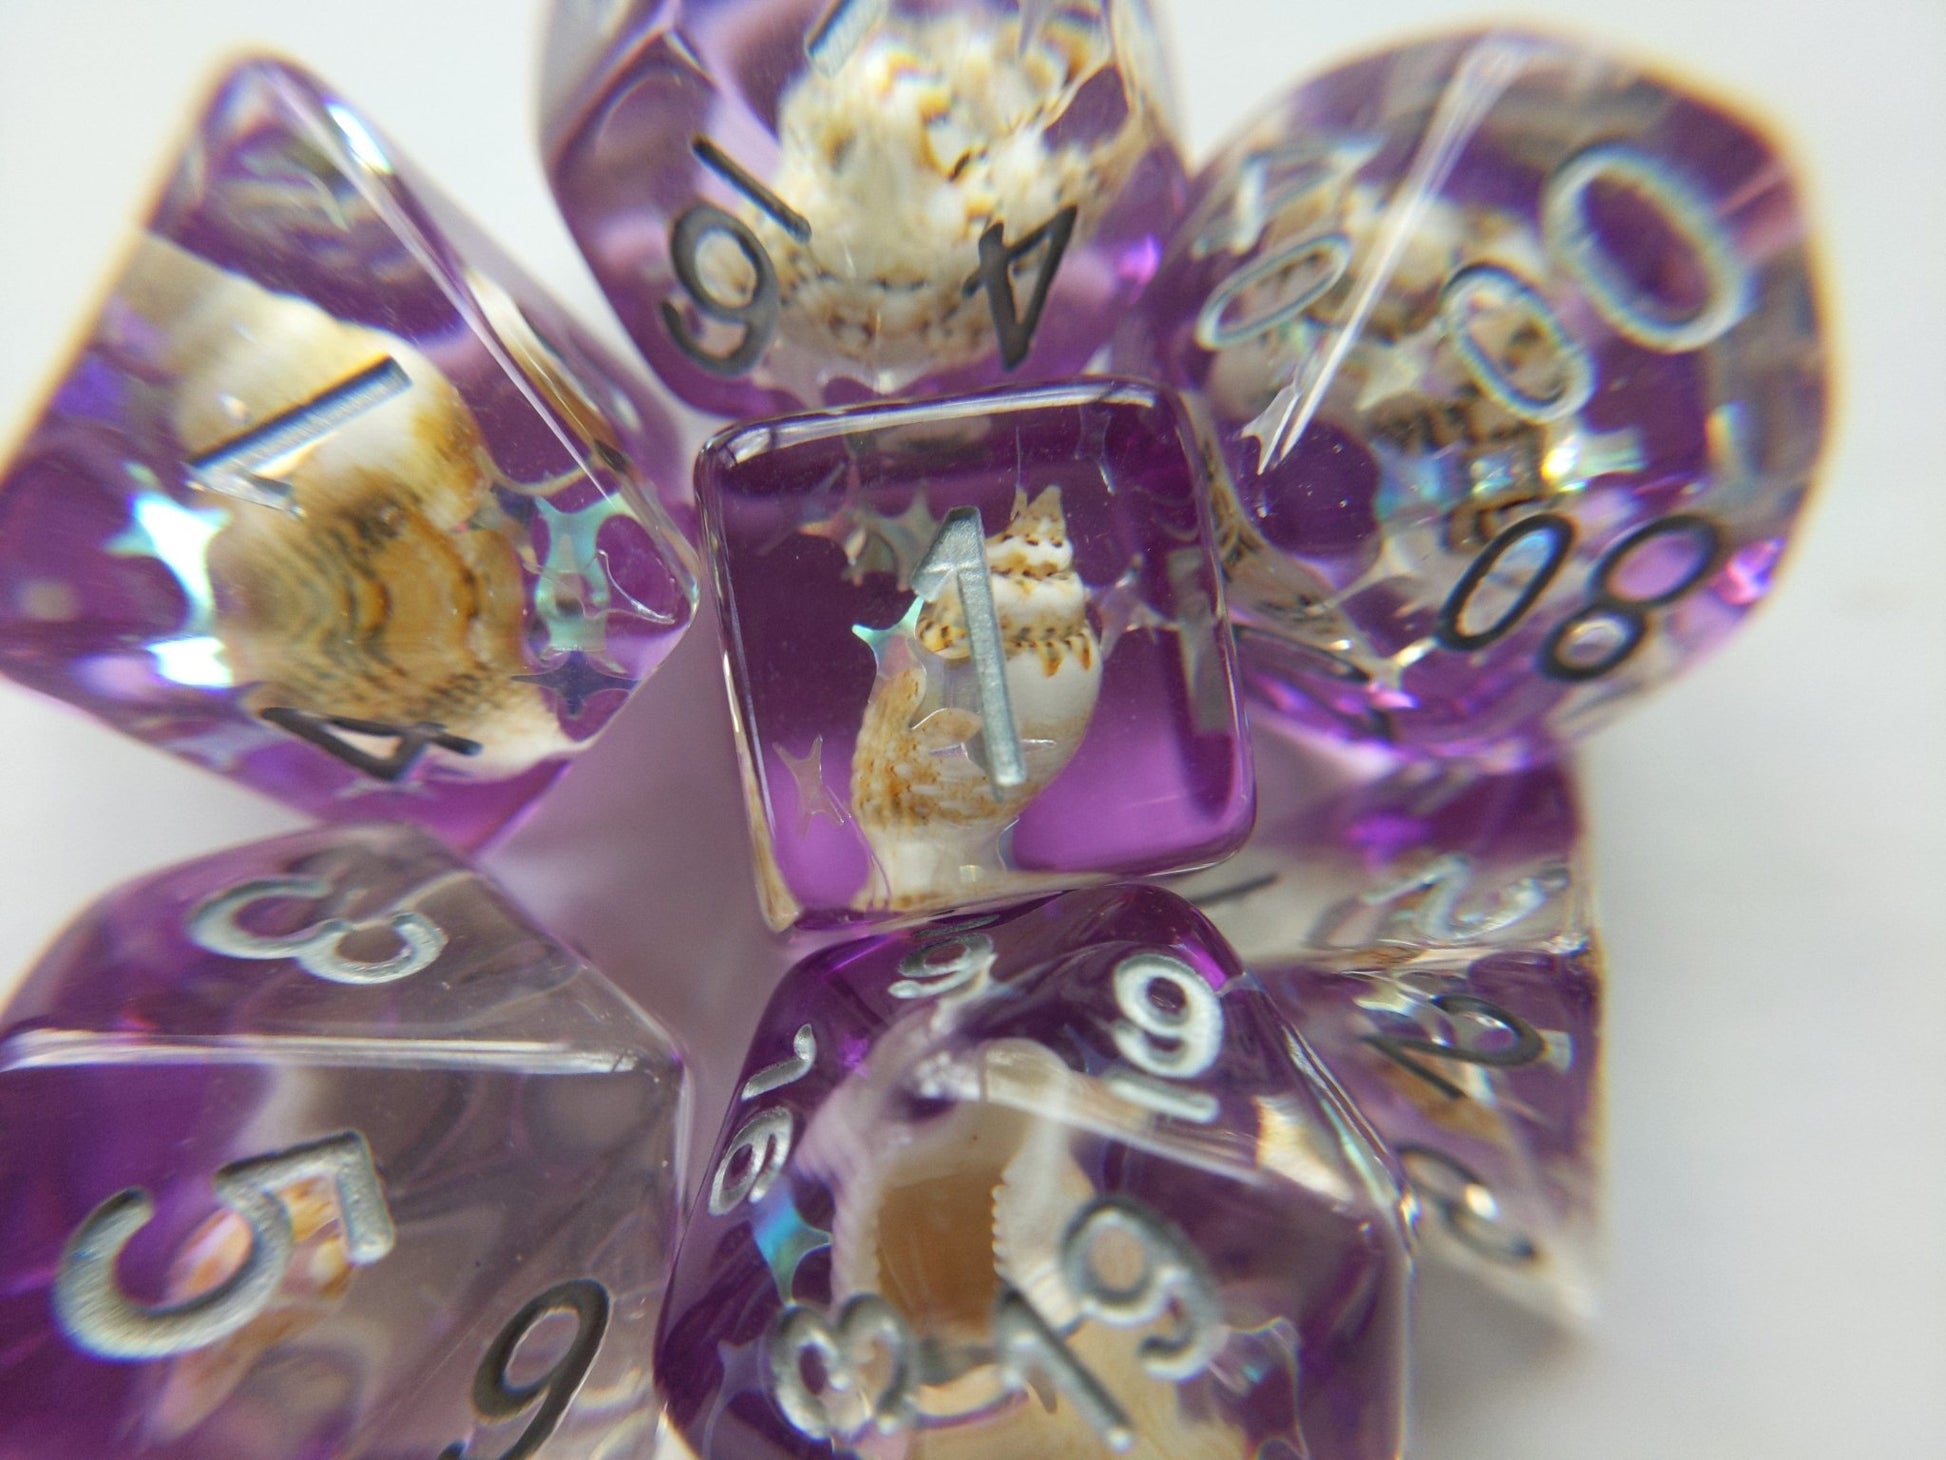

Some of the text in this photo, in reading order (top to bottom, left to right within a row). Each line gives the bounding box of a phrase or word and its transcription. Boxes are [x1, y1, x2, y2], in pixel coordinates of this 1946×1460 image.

[962, 205, 1077, 370] 4
[185, 355, 411, 517] 1
[911, 507, 1026, 785] 1
[260, 707, 483, 781] 4
[190, 878, 449, 984] 3
[52, 1129, 396, 1362] 5
